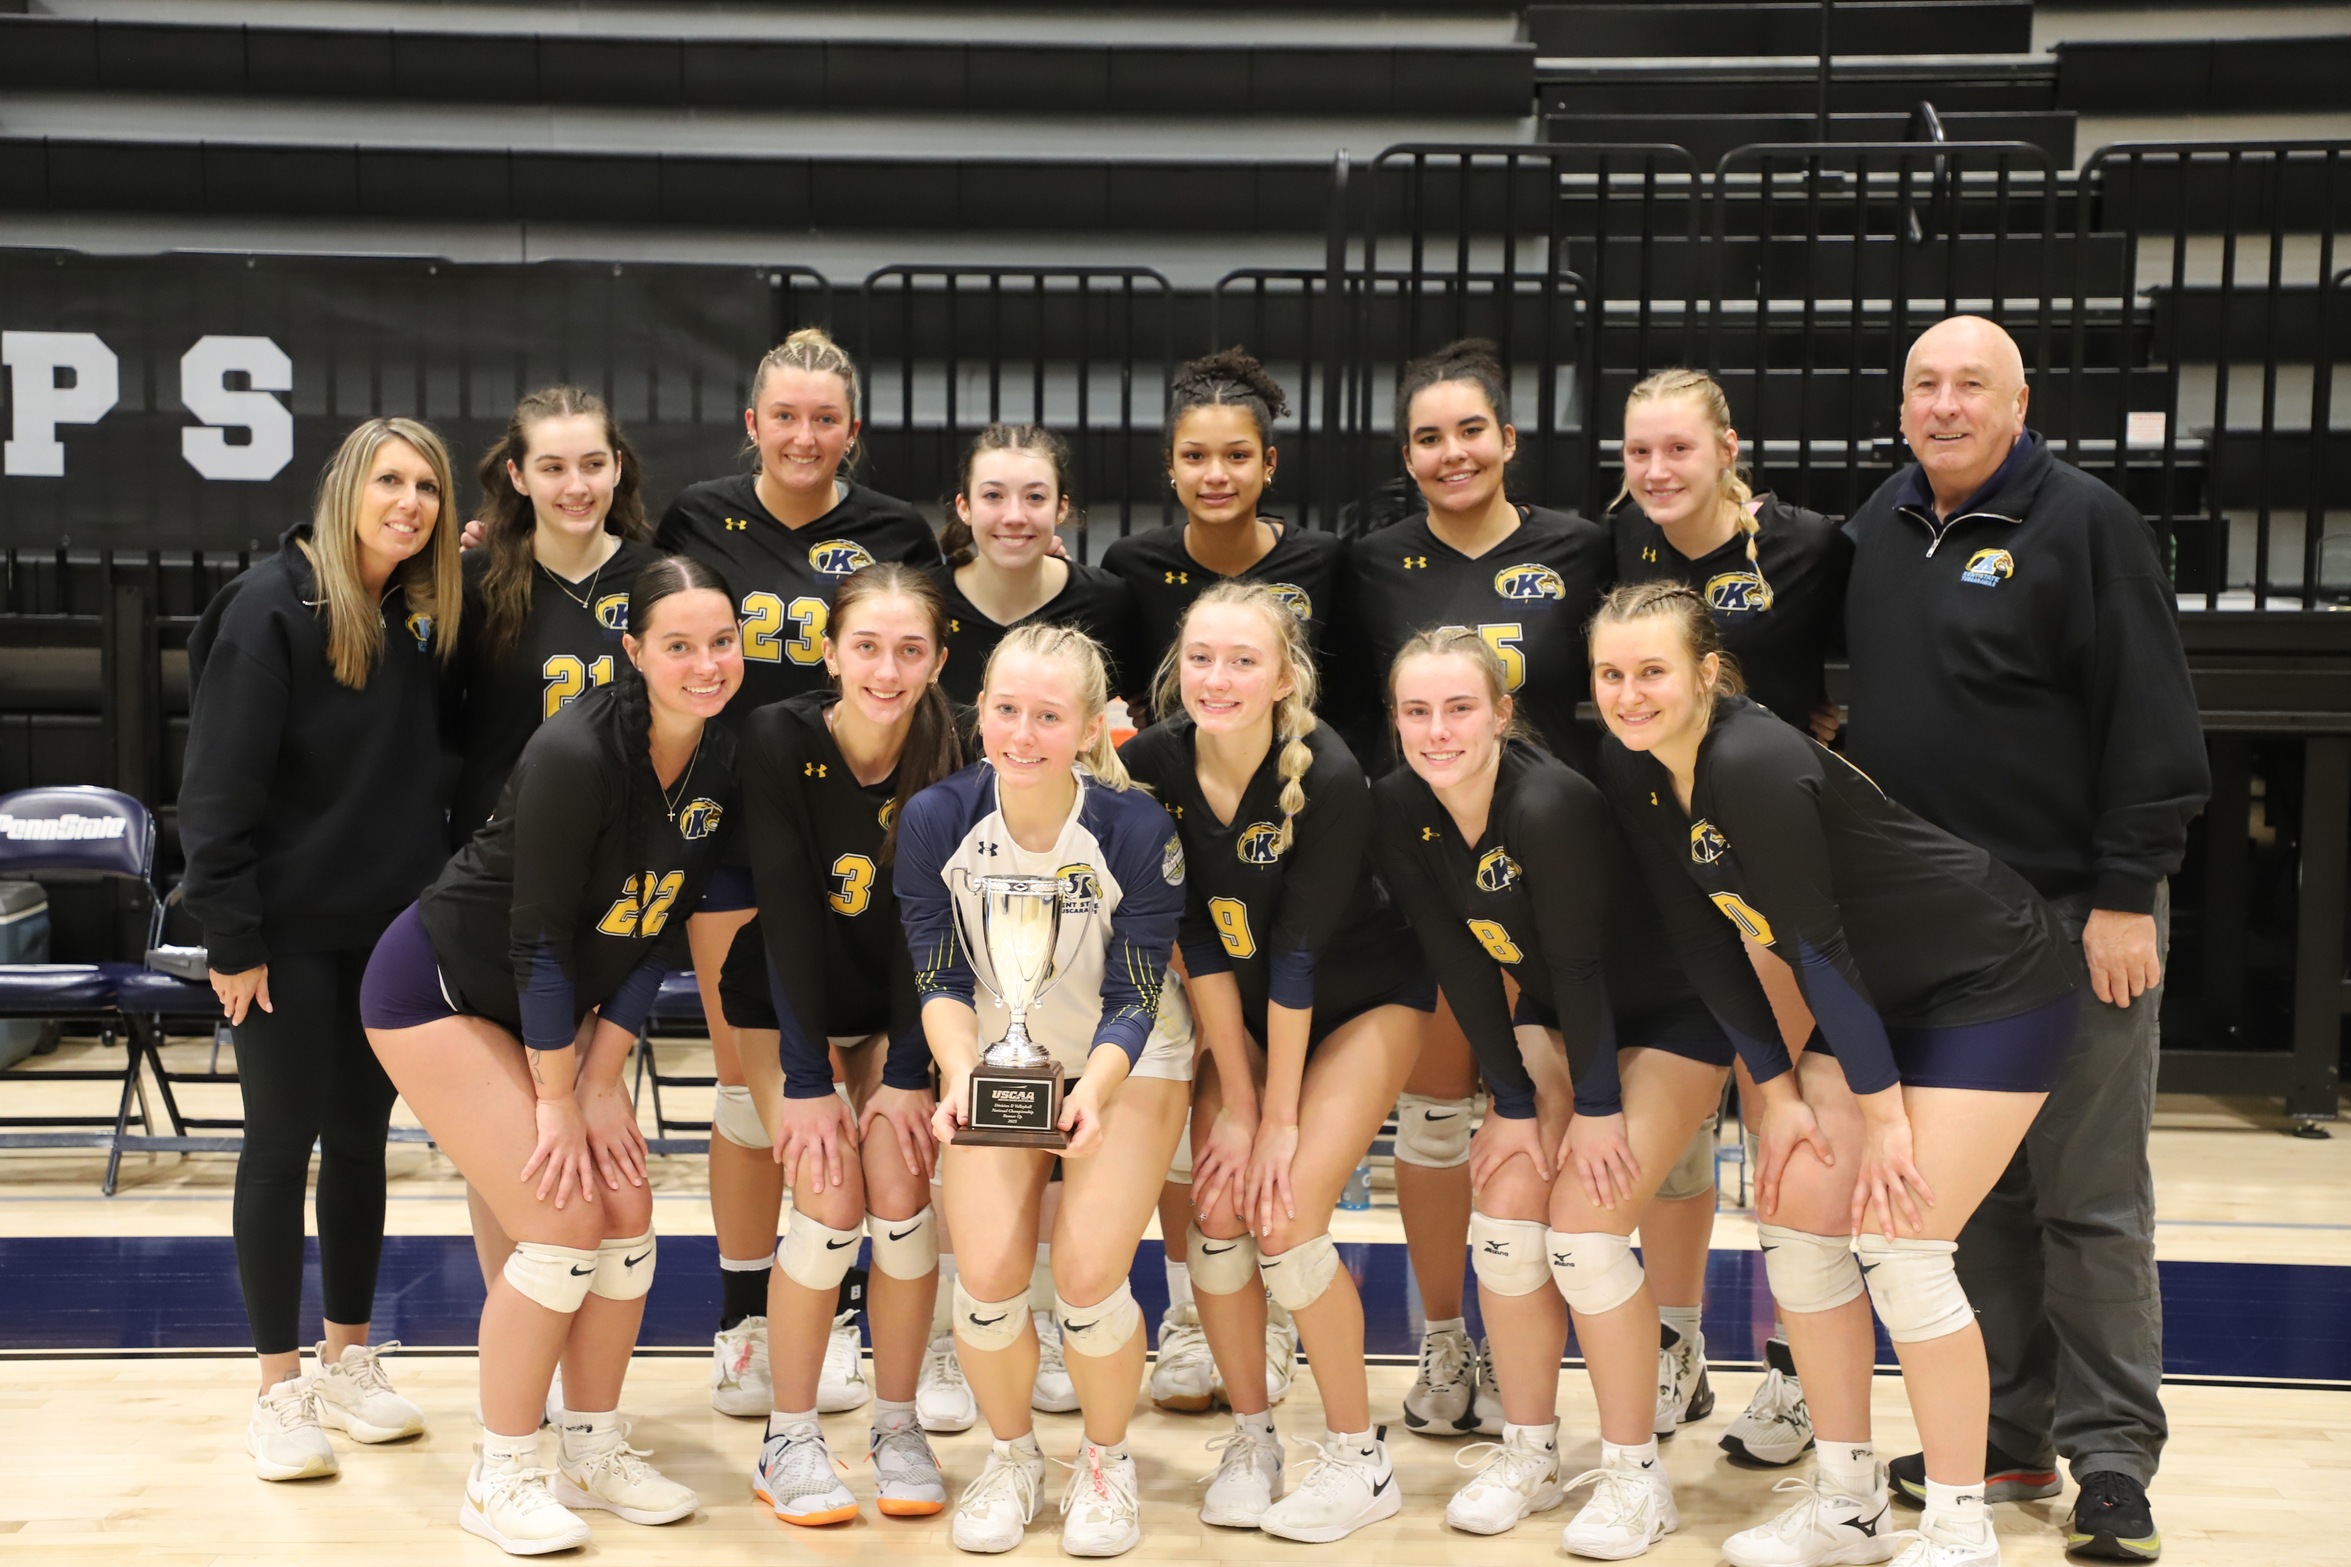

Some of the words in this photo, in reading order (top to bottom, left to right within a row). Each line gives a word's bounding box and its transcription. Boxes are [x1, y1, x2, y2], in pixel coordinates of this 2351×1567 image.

[741, 591, 830, 666] 23
[543, 655, 614, 722] 21
[596, 870, 686, 939] 22
[828, 852, 876, 917] 3
[1208, 896, 1257, 959] 9
[1467, 918, 1524, 964] 8
[1708, 891, 1777, 947] 0
[992, 1090, 1034, 1100] USCAA
